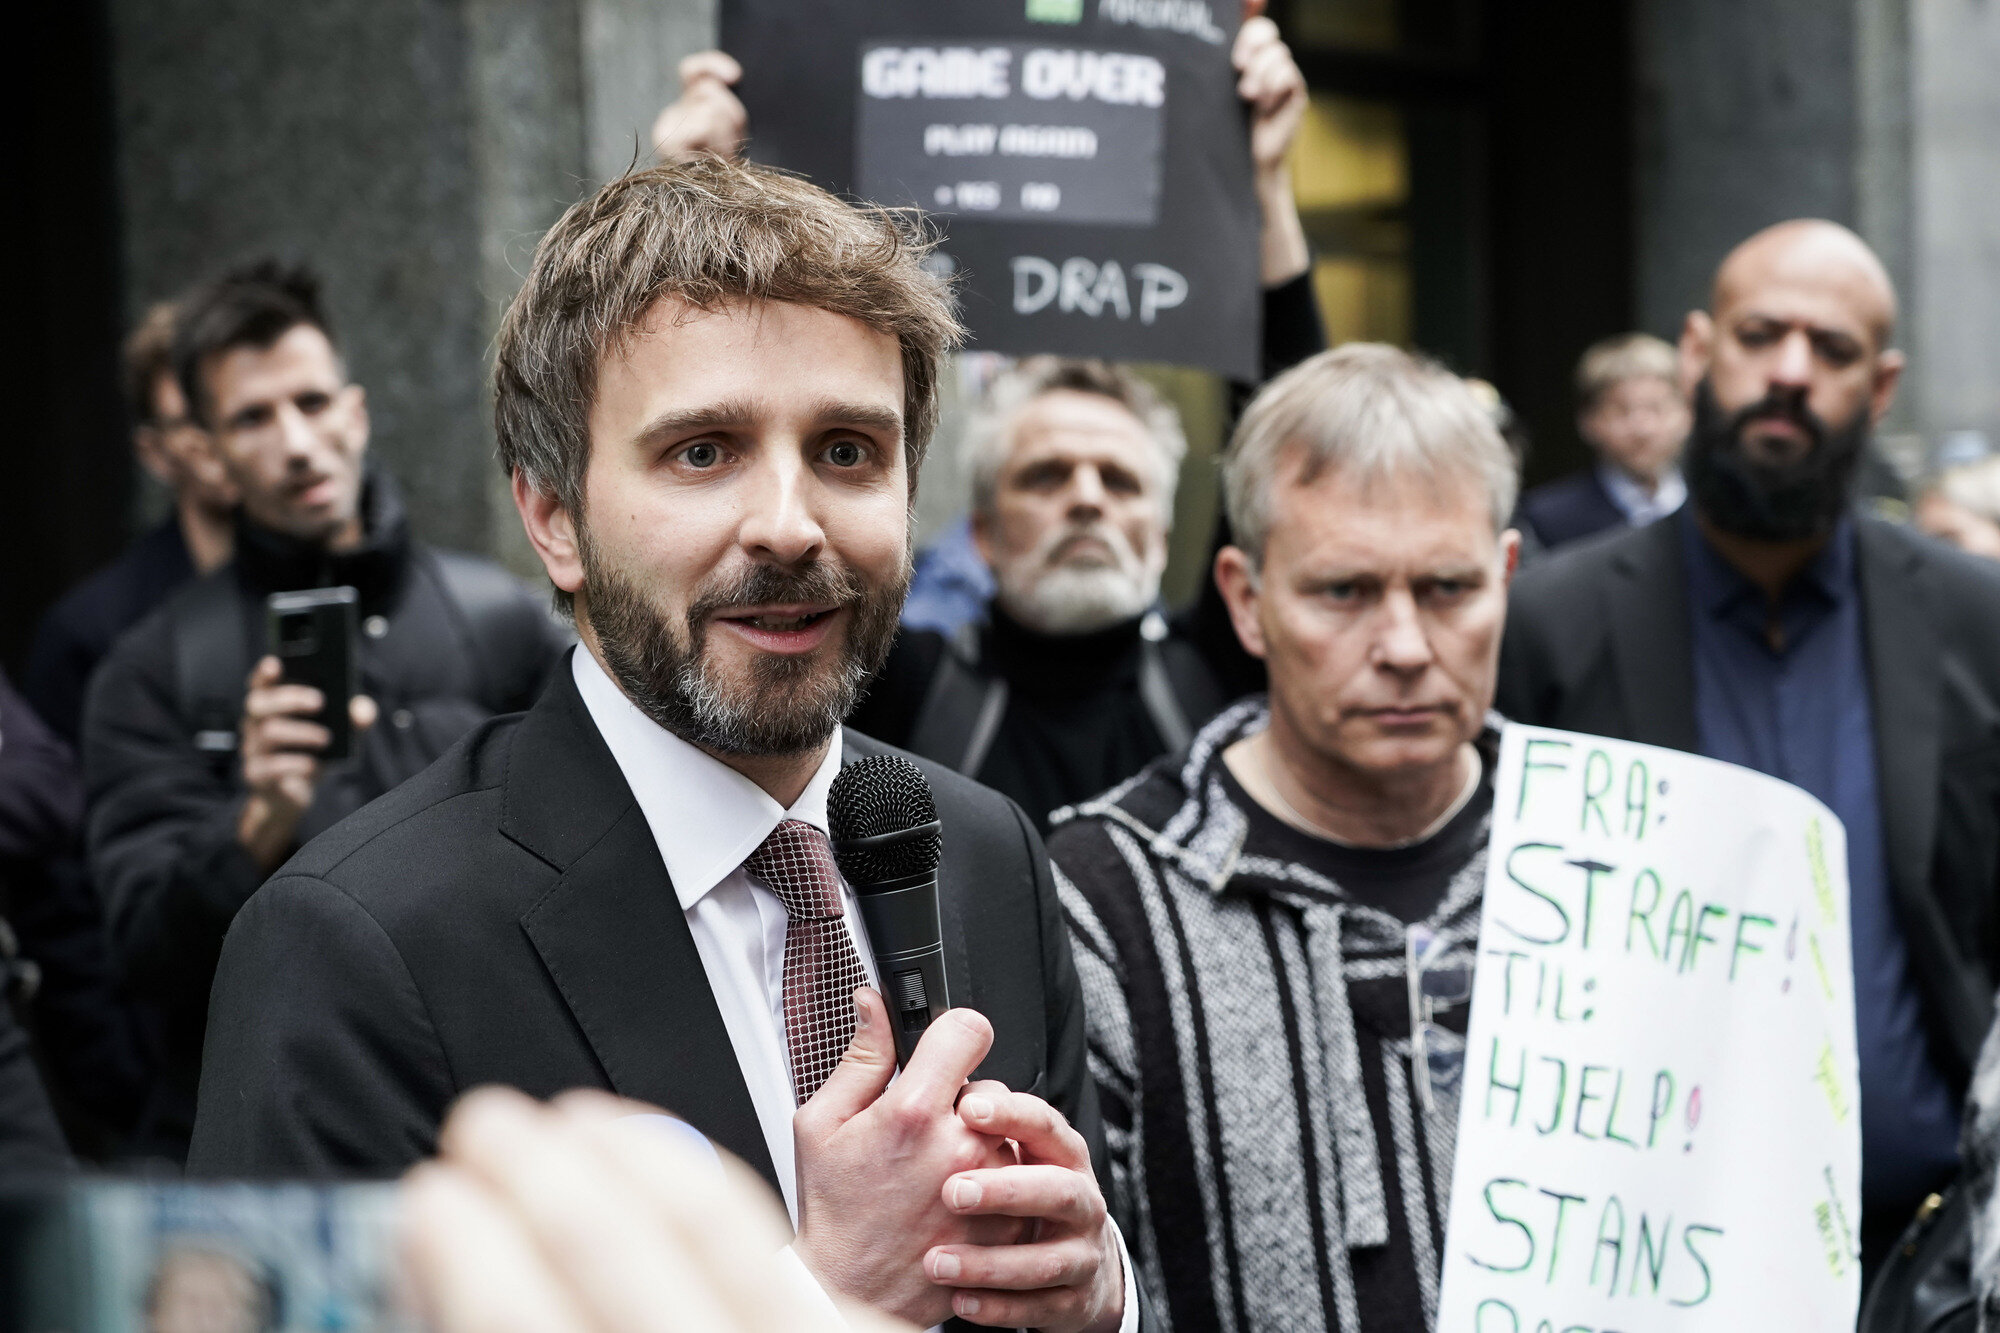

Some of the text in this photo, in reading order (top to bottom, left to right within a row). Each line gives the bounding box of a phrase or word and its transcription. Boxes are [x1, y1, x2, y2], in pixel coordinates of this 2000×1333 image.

[862, 47, 1165, 107] GAME OVER
[1010, 256, 1189, 325] DRAP
[1515, 738, 1671, 840] FRA:
[1494, 842, 1799, 994] STRAFF!
[1488, 948, 1597, 1022] TIL:
[1484, 1036, 1703, 1155] HJELP!
[1464, 1177, 1726, 1307] STANS
